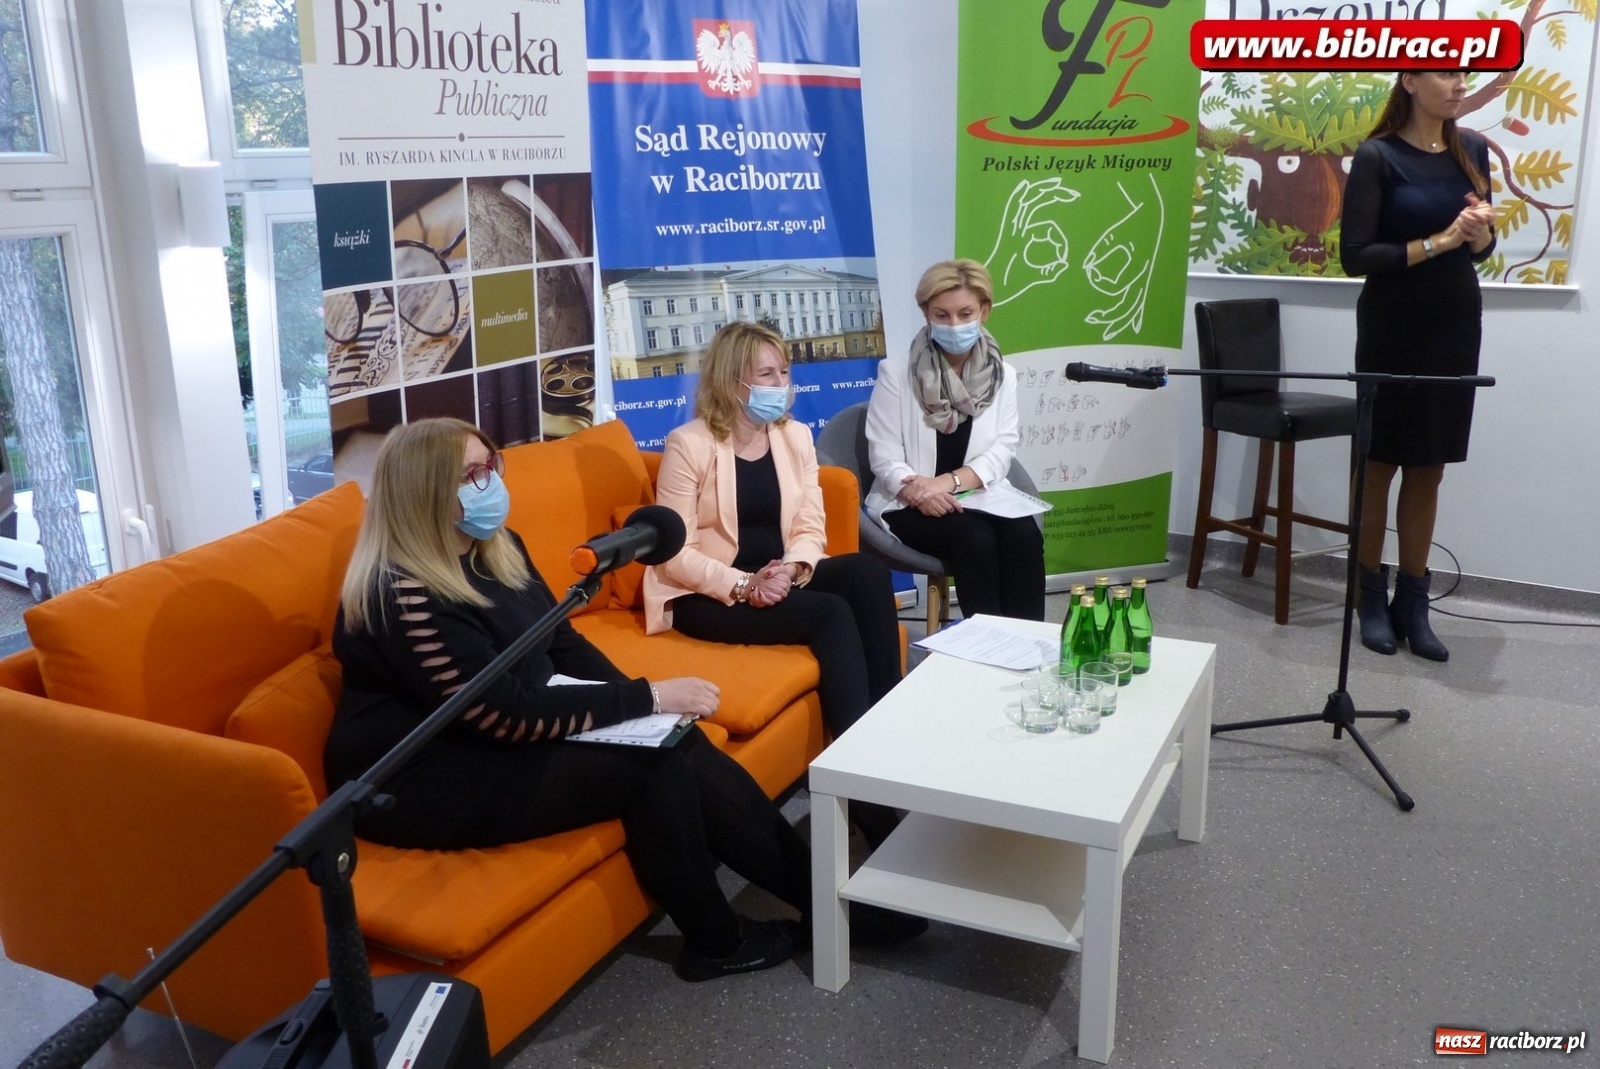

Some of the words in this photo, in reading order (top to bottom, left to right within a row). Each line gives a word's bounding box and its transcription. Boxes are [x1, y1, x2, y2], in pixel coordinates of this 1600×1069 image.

[333, 0, 563, 76] Biblioteka
[434, 79, 548, 121] Publiczna
[634, 124, 689, 157] Sąd
[697, 123, 827, 156] Rejonowy
[339, 152, 360, 166] IM.
[366, 150, 435, 166] RYSZARDA
[440, 149, 484, 163] KINCLA
[488, 148, 498, 161] W
[502, 147, 567, 161] RACIBORZU
[981, 156, 1041, 172] Polski
[1044, 154, 1097, 173] Język
[1102, 154, 1173, 172] Migowy
[650, 174, 674, 194] w
[683, 164, 821, 193] Raciborzu
[656, 216, 826, 236] www.raciborz.sr.gov.pl
[333, 228, 371, 250] książki
[481, 308, 529, 328] multimedia
